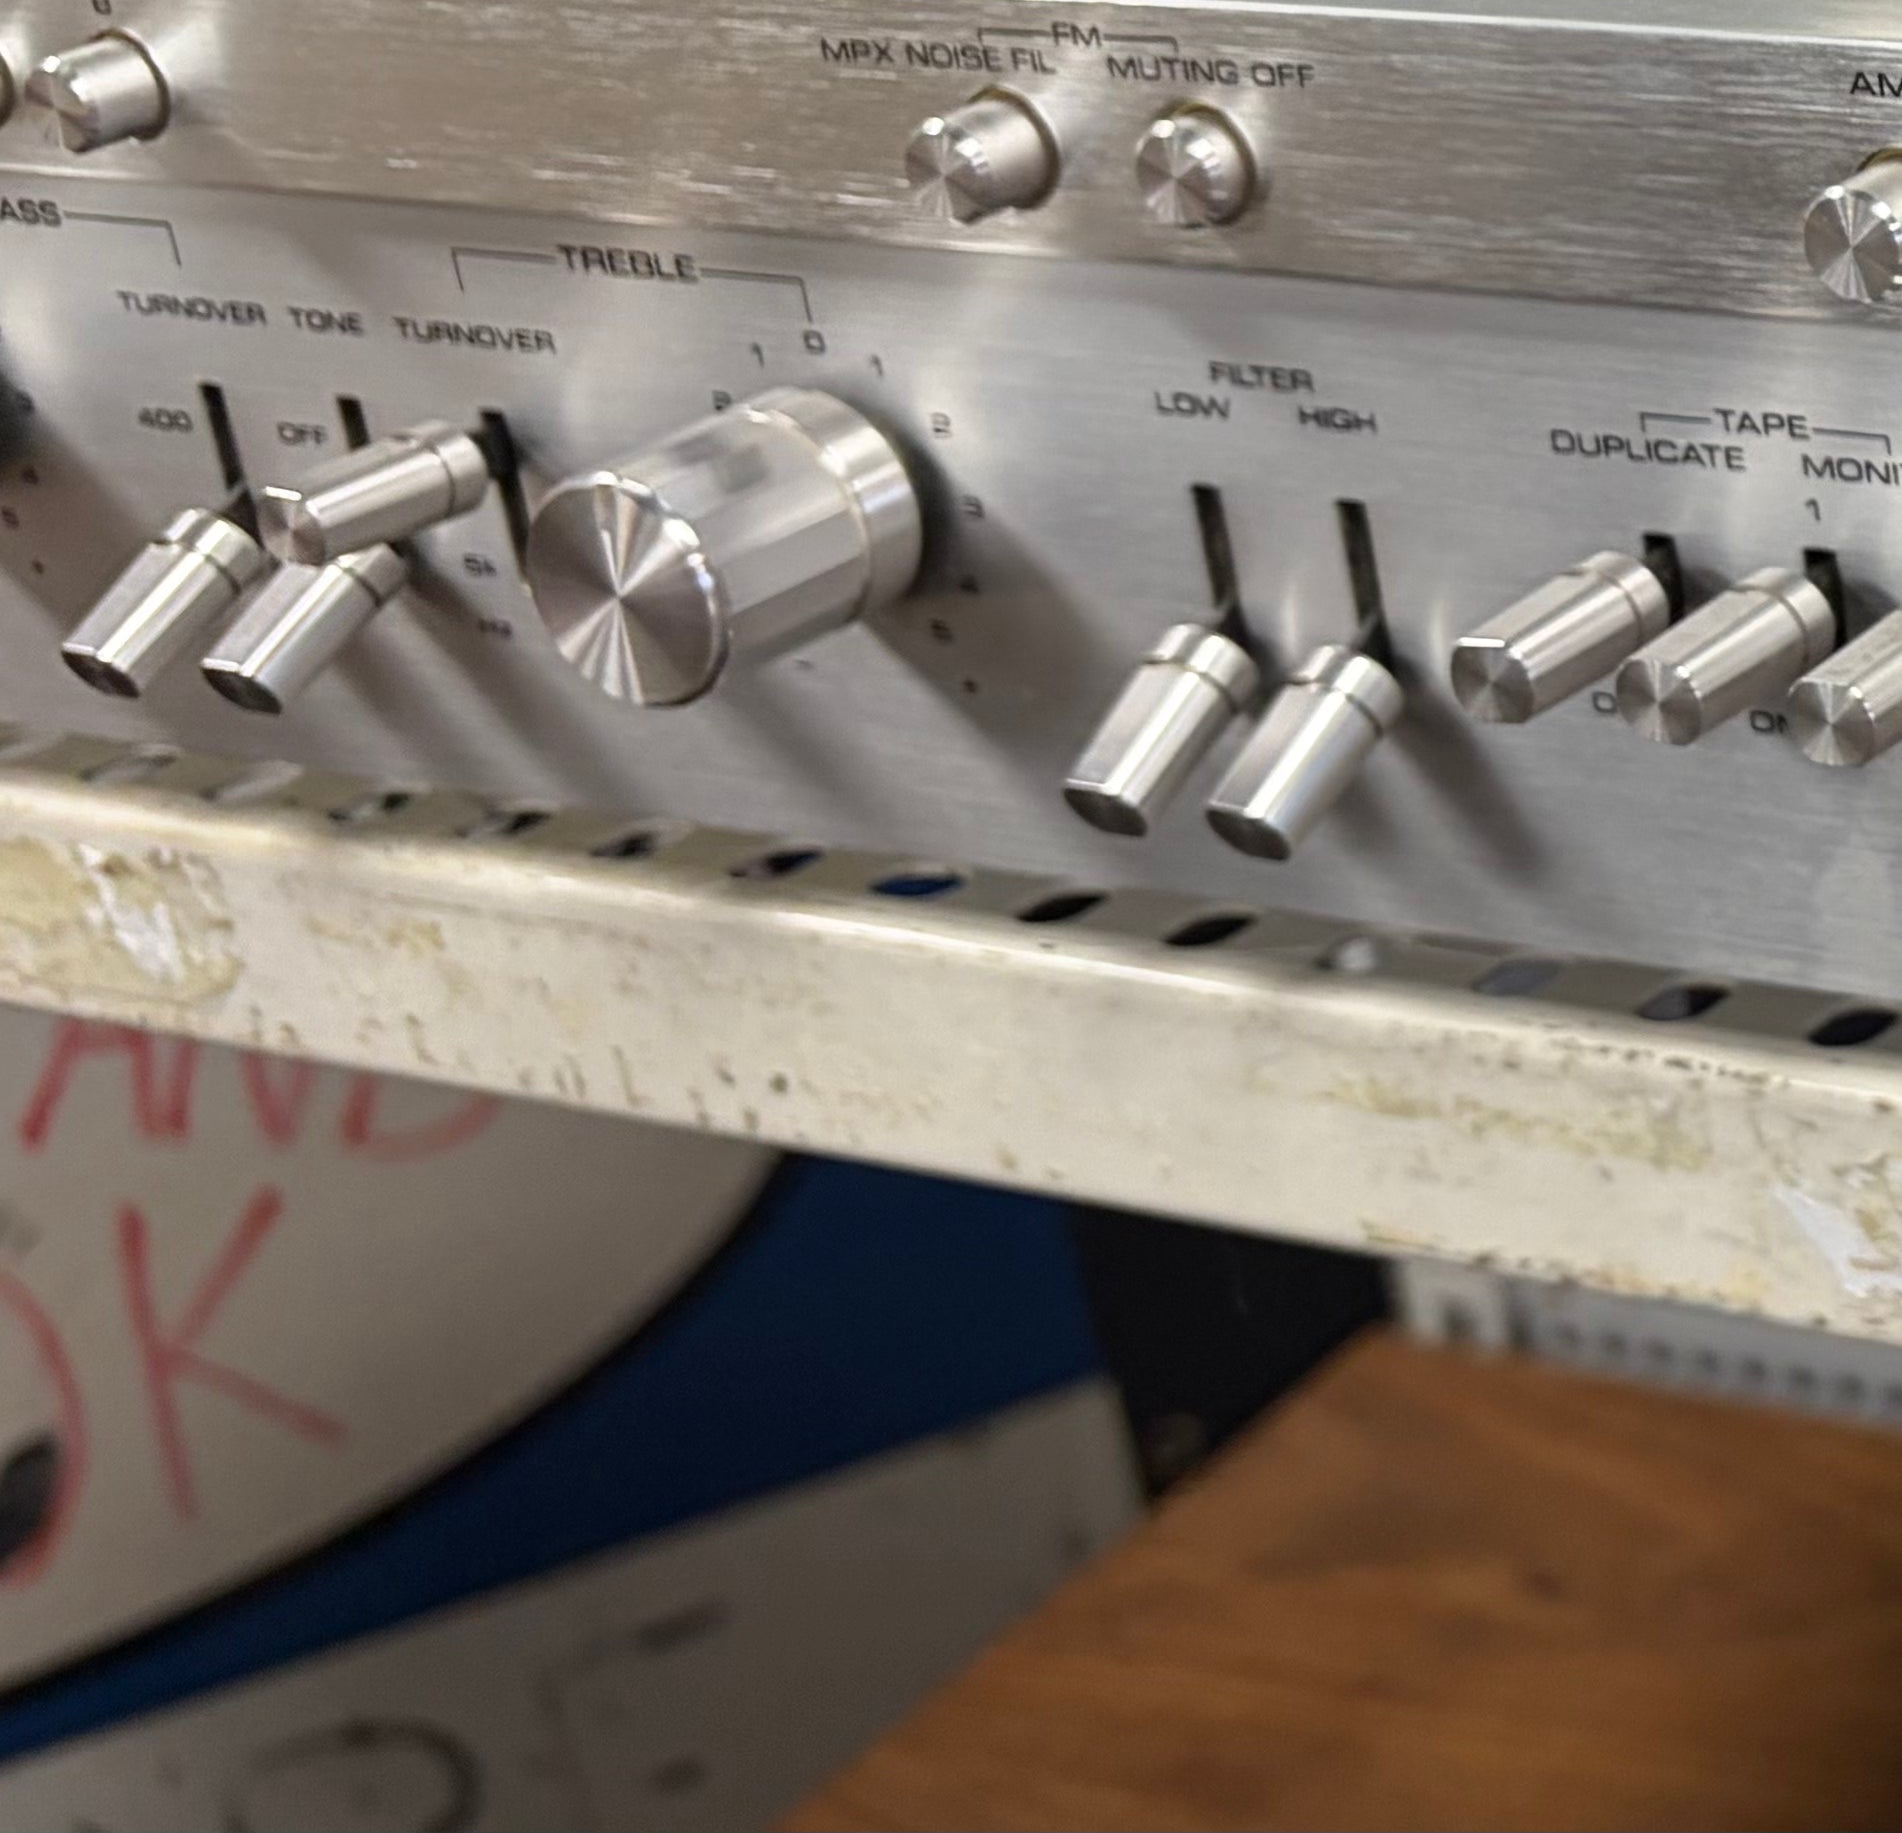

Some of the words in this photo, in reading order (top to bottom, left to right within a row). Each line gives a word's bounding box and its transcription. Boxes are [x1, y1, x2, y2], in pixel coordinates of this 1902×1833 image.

[1052, 21, 1101, 48] FM
[821, 37, 894, 66] MPX
[905, 42, 1001, 70] NOISE
[1012, 49, 1058, 75] FIL
[1106, 55, 1239, 85] MUTING
[1250, 64, 1316, 88] OFF
[558, 245, 698, 283] TREBLE
[116, 290, 266, 325] TURNOVER
[287, 306, 364, 335] TONE
[393, 315, 556, 353] TURNOVER
[1208, 360, 1315, 393] FILTER
[1155, 391, 1230, 420] LOW
[1298, 404, 1377, 434] HIGH
[1714, 408, 1810, 439] TAPE
[1551, 428, 1746, 471] DUPLICATE
[1805, 499, 1821, 520] 1
